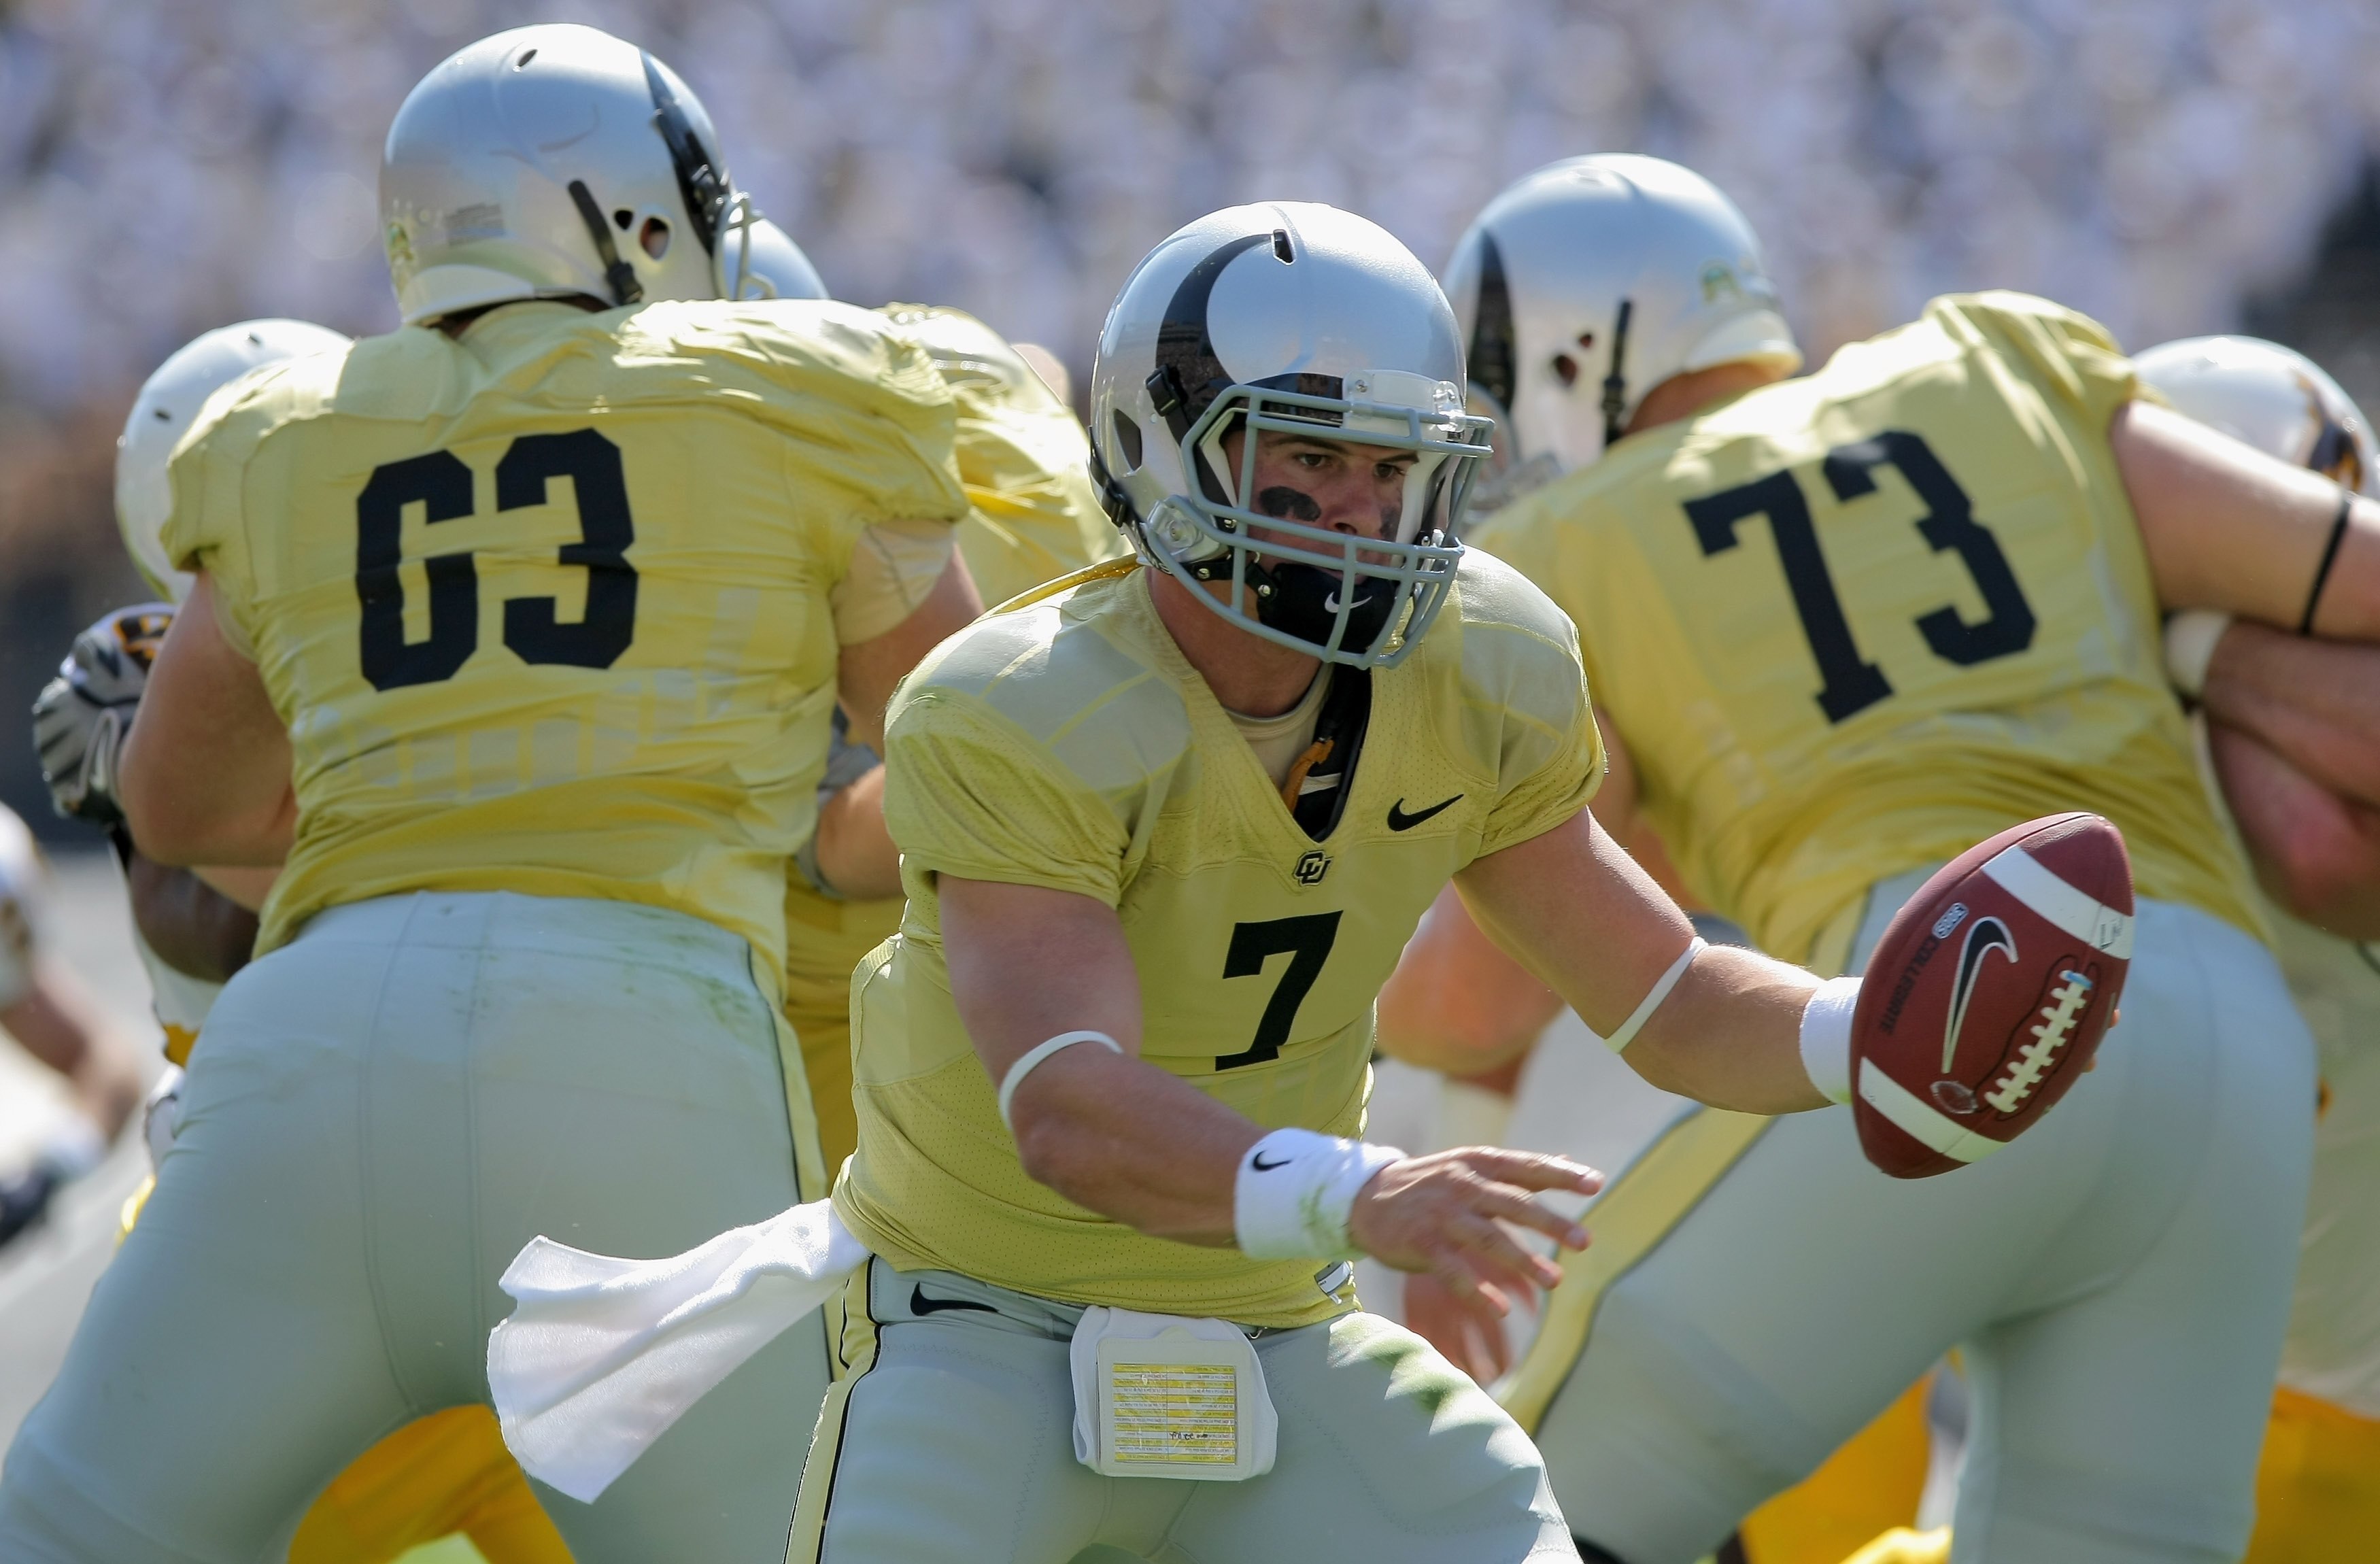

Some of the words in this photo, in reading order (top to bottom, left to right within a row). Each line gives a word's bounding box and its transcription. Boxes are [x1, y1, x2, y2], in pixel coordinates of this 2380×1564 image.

[356, 428, 639, 692] 63
[1683, 430, 2037, 724] 73
[1215, 911, 1344, 1072] 7
